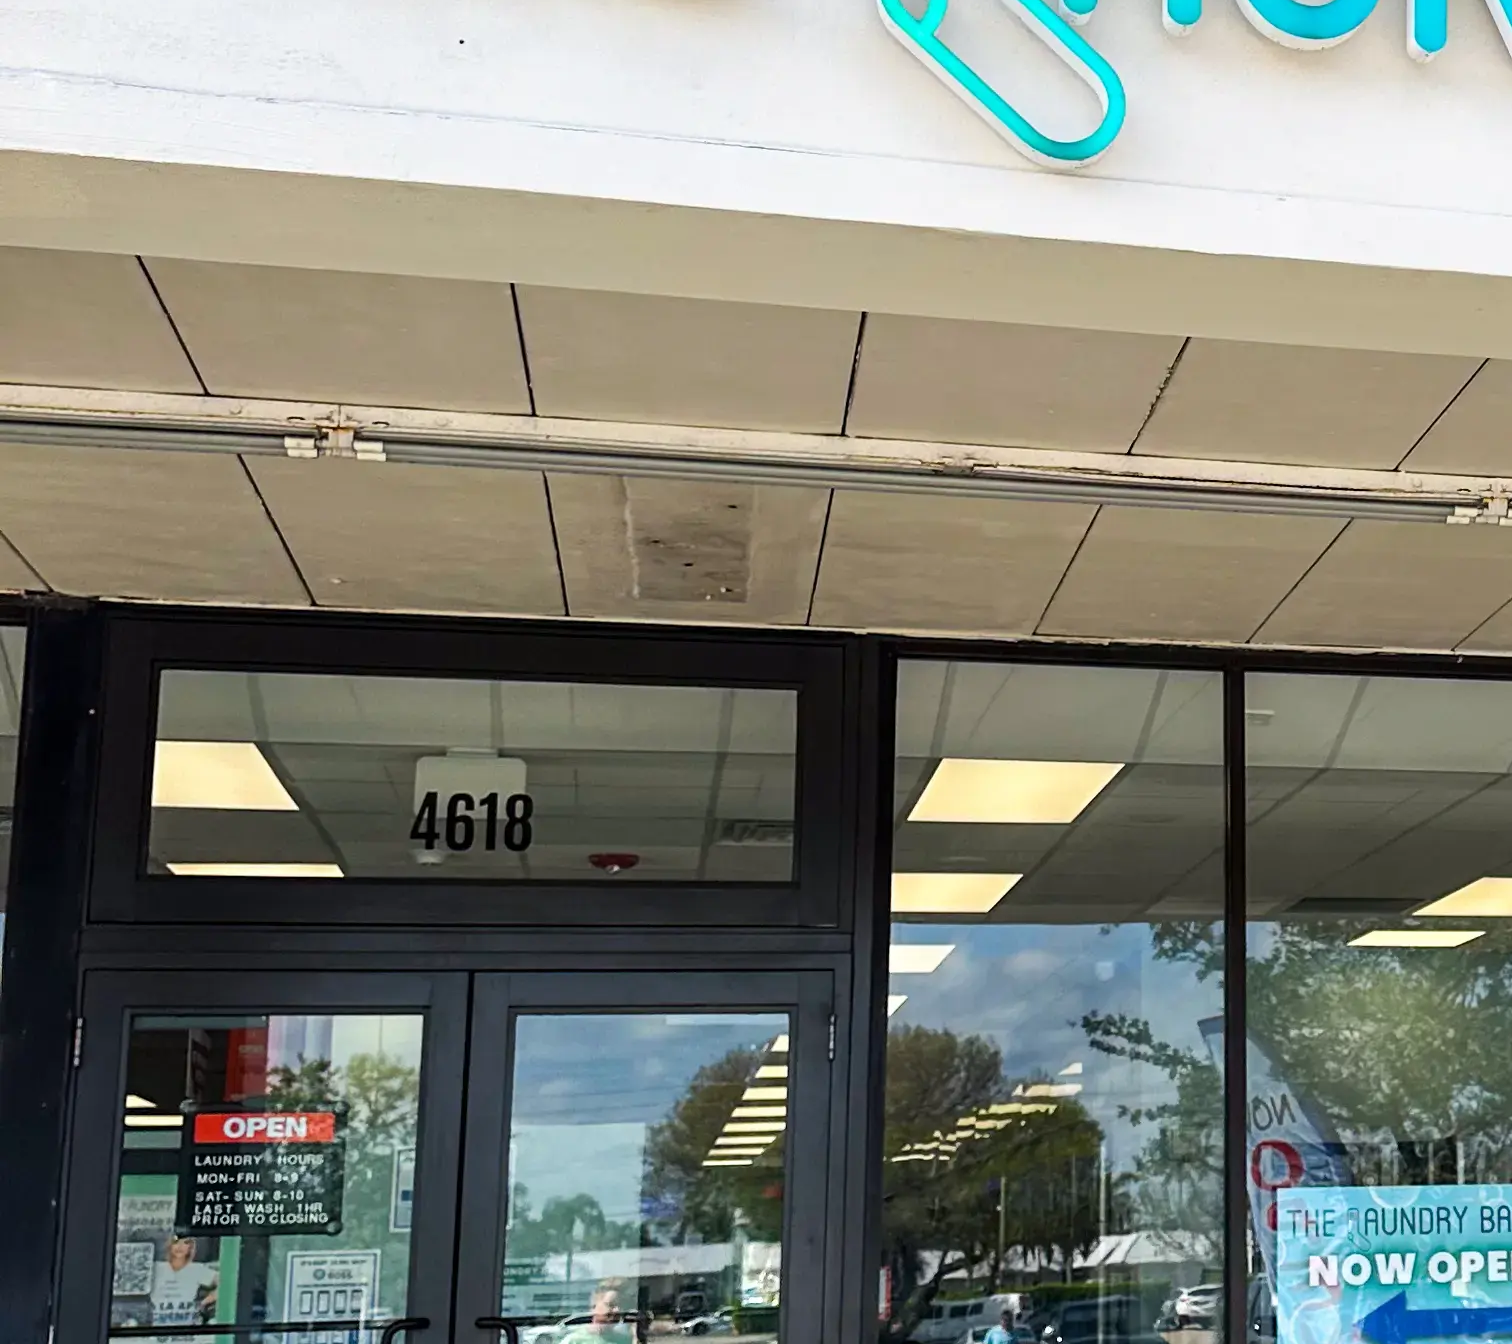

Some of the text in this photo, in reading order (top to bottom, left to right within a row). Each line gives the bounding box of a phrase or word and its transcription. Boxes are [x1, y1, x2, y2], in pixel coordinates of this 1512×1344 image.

[409, 790, 534, 853] 4618
[222, 1115, 309, 1140] OPEN
[194, 1153, 325, 1167] LAUNDRY HOURS
[196, 1172, 261, 1185] MON-FRI
[193, 1203, 234, 1216] LAST
[243, 1202, 285, 1215] WASH
[191, 1212, 330, 1227] PRIOR TO CLOSING
[1286, 1207, 1337, 1239] THE
[1307, 1251, 1417, 1288] NOW
